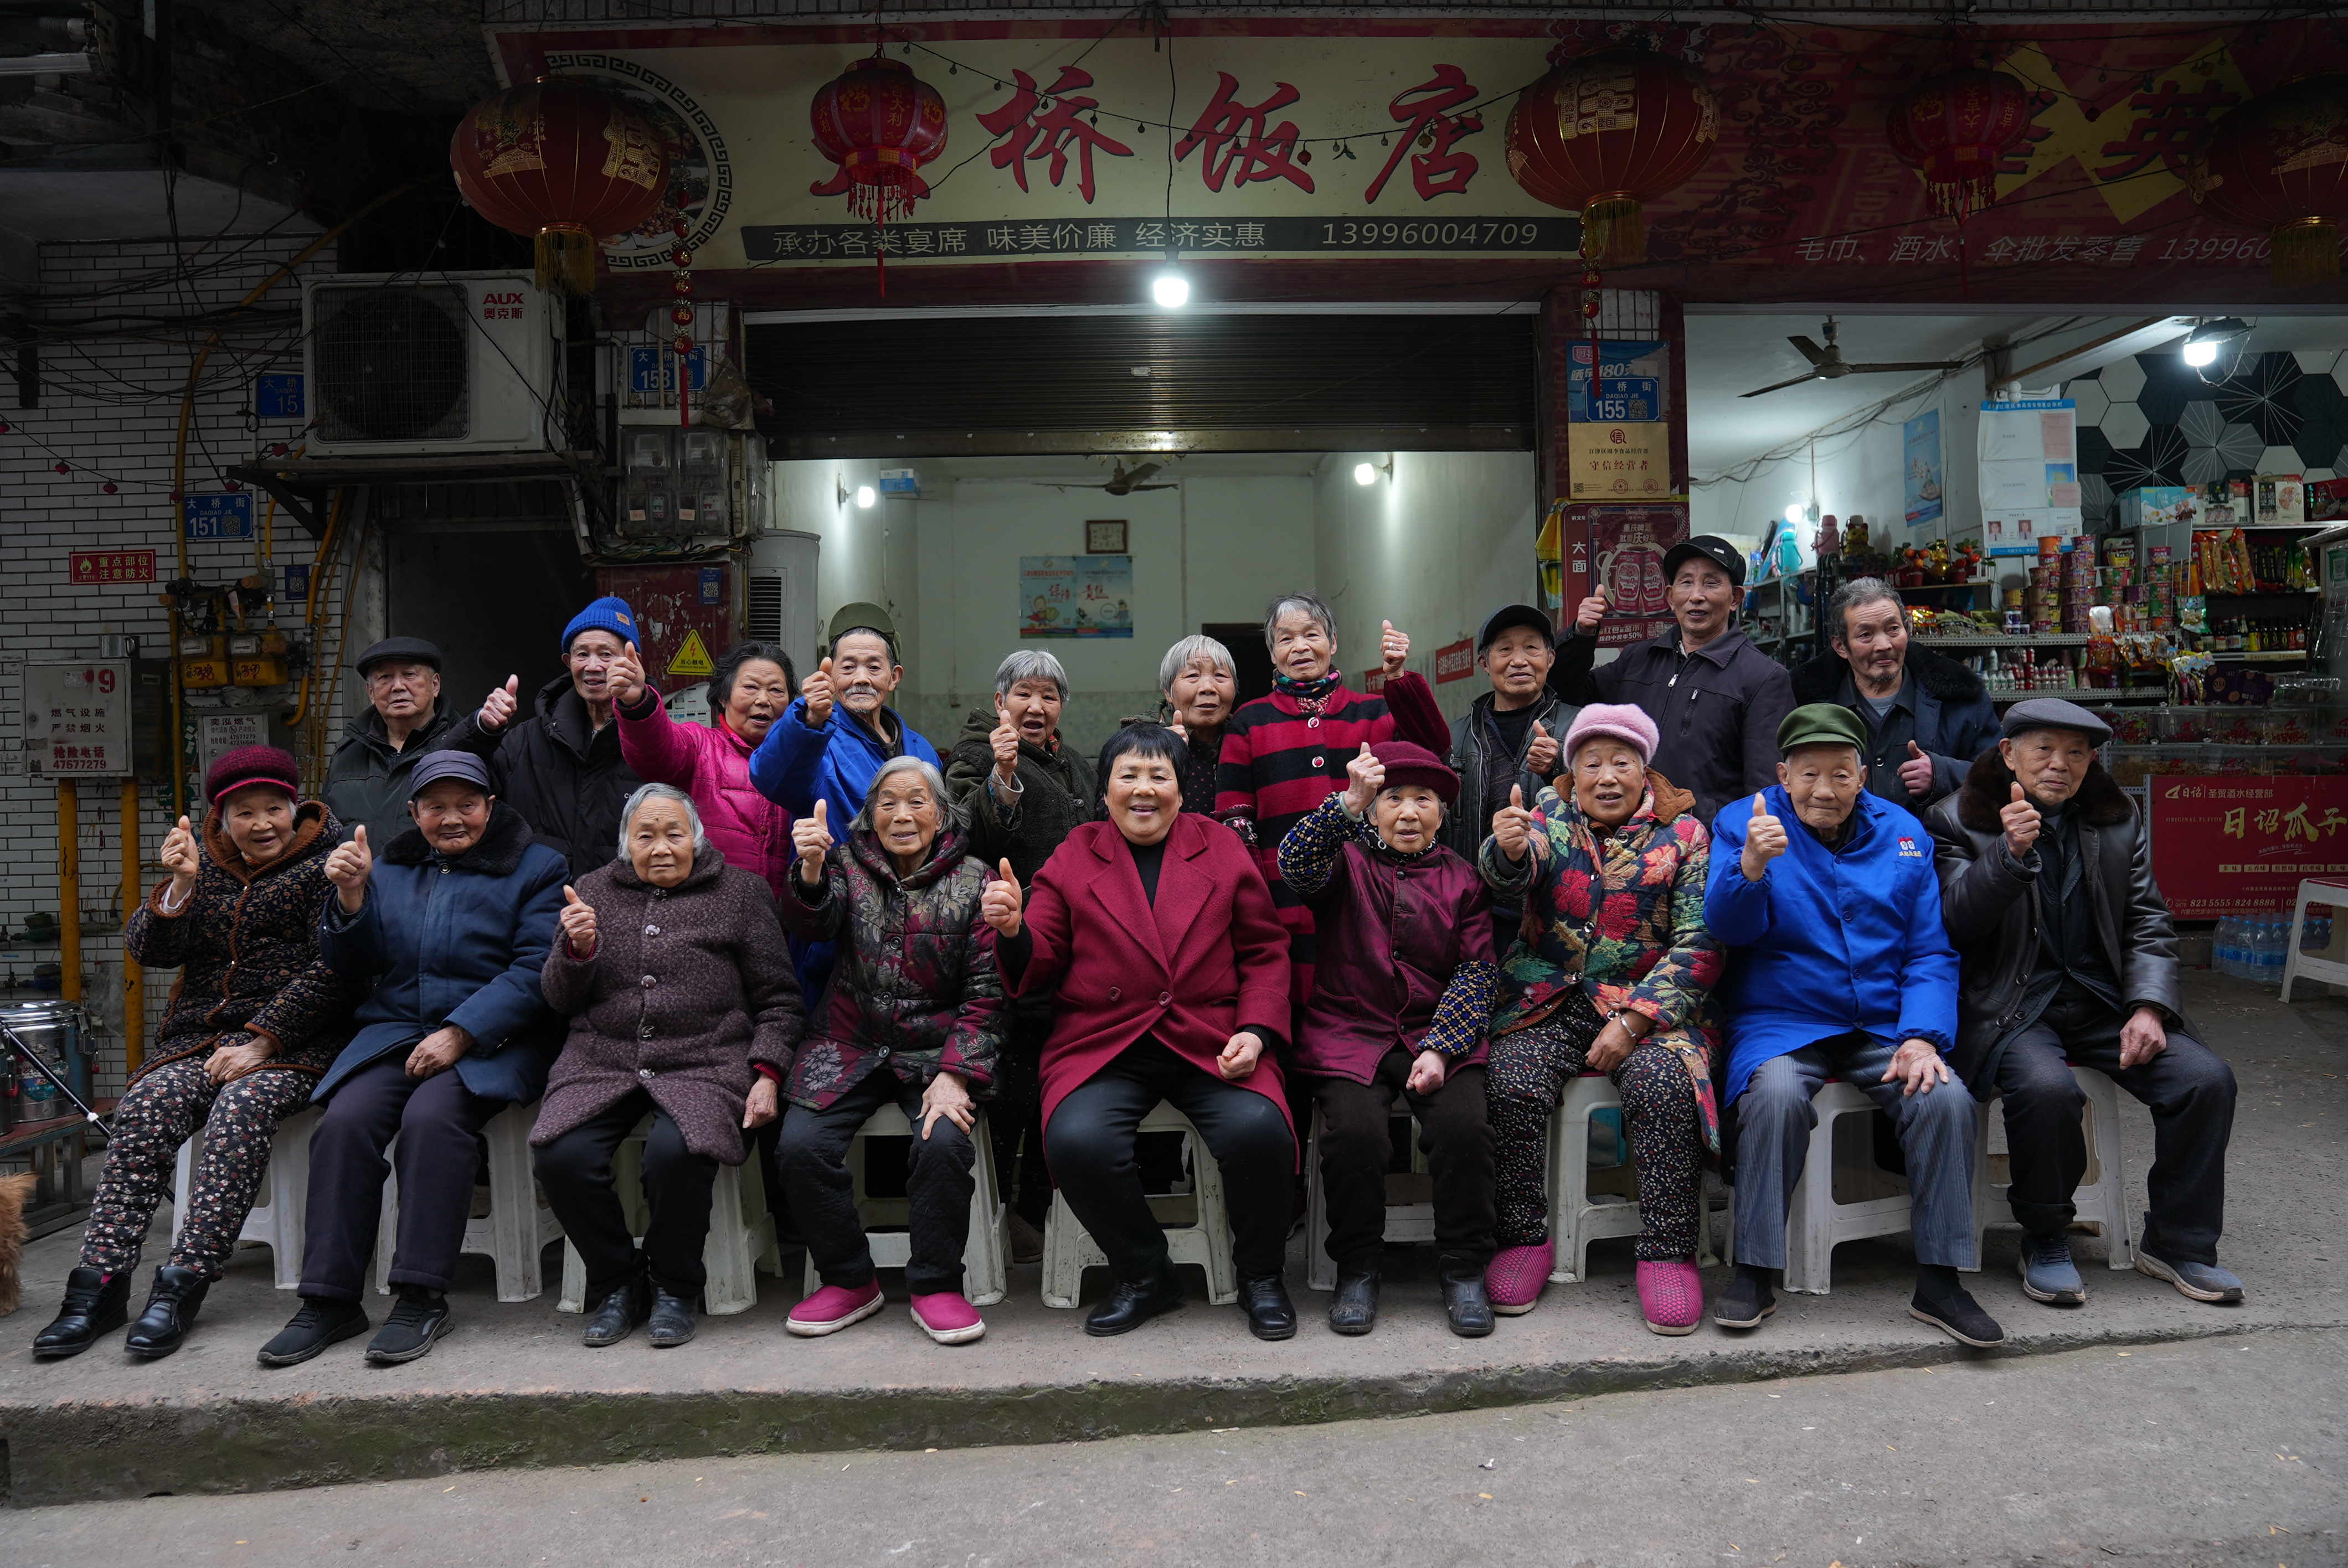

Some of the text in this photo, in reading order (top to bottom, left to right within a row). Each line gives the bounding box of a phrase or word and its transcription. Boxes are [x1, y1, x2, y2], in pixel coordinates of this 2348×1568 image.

[774, 221, 1538, 256] 承办各类宴席 味美价廉 经济实惠 13996004709
[483, 293, 524, 305] AUX
[483, 307, 523, 319] 奥克斯
[277, 395, 304, 414] 15
[1595, 400, 1625, 419] 155
[1590, 460, 1649, 471] 守信经营者
[187, 497, 245, 509] 大桥街
[189, 517, 218, 536] 151
[99, 555, 148, 567] 重点部位
[99, 568, 149, 579] 注意防火
[51, 708, 105, 717] 燃气设施
[52, 724, 105, 733] 严禁烟火
[54, 746, 105, 758] 抢险电话
[53, 760, 106, 769] 47577279
[2190, 899, 2207, 907] 823
[2208, 899, 2231, 907] 5555
[2253, 899, 2276, 907] 8888
